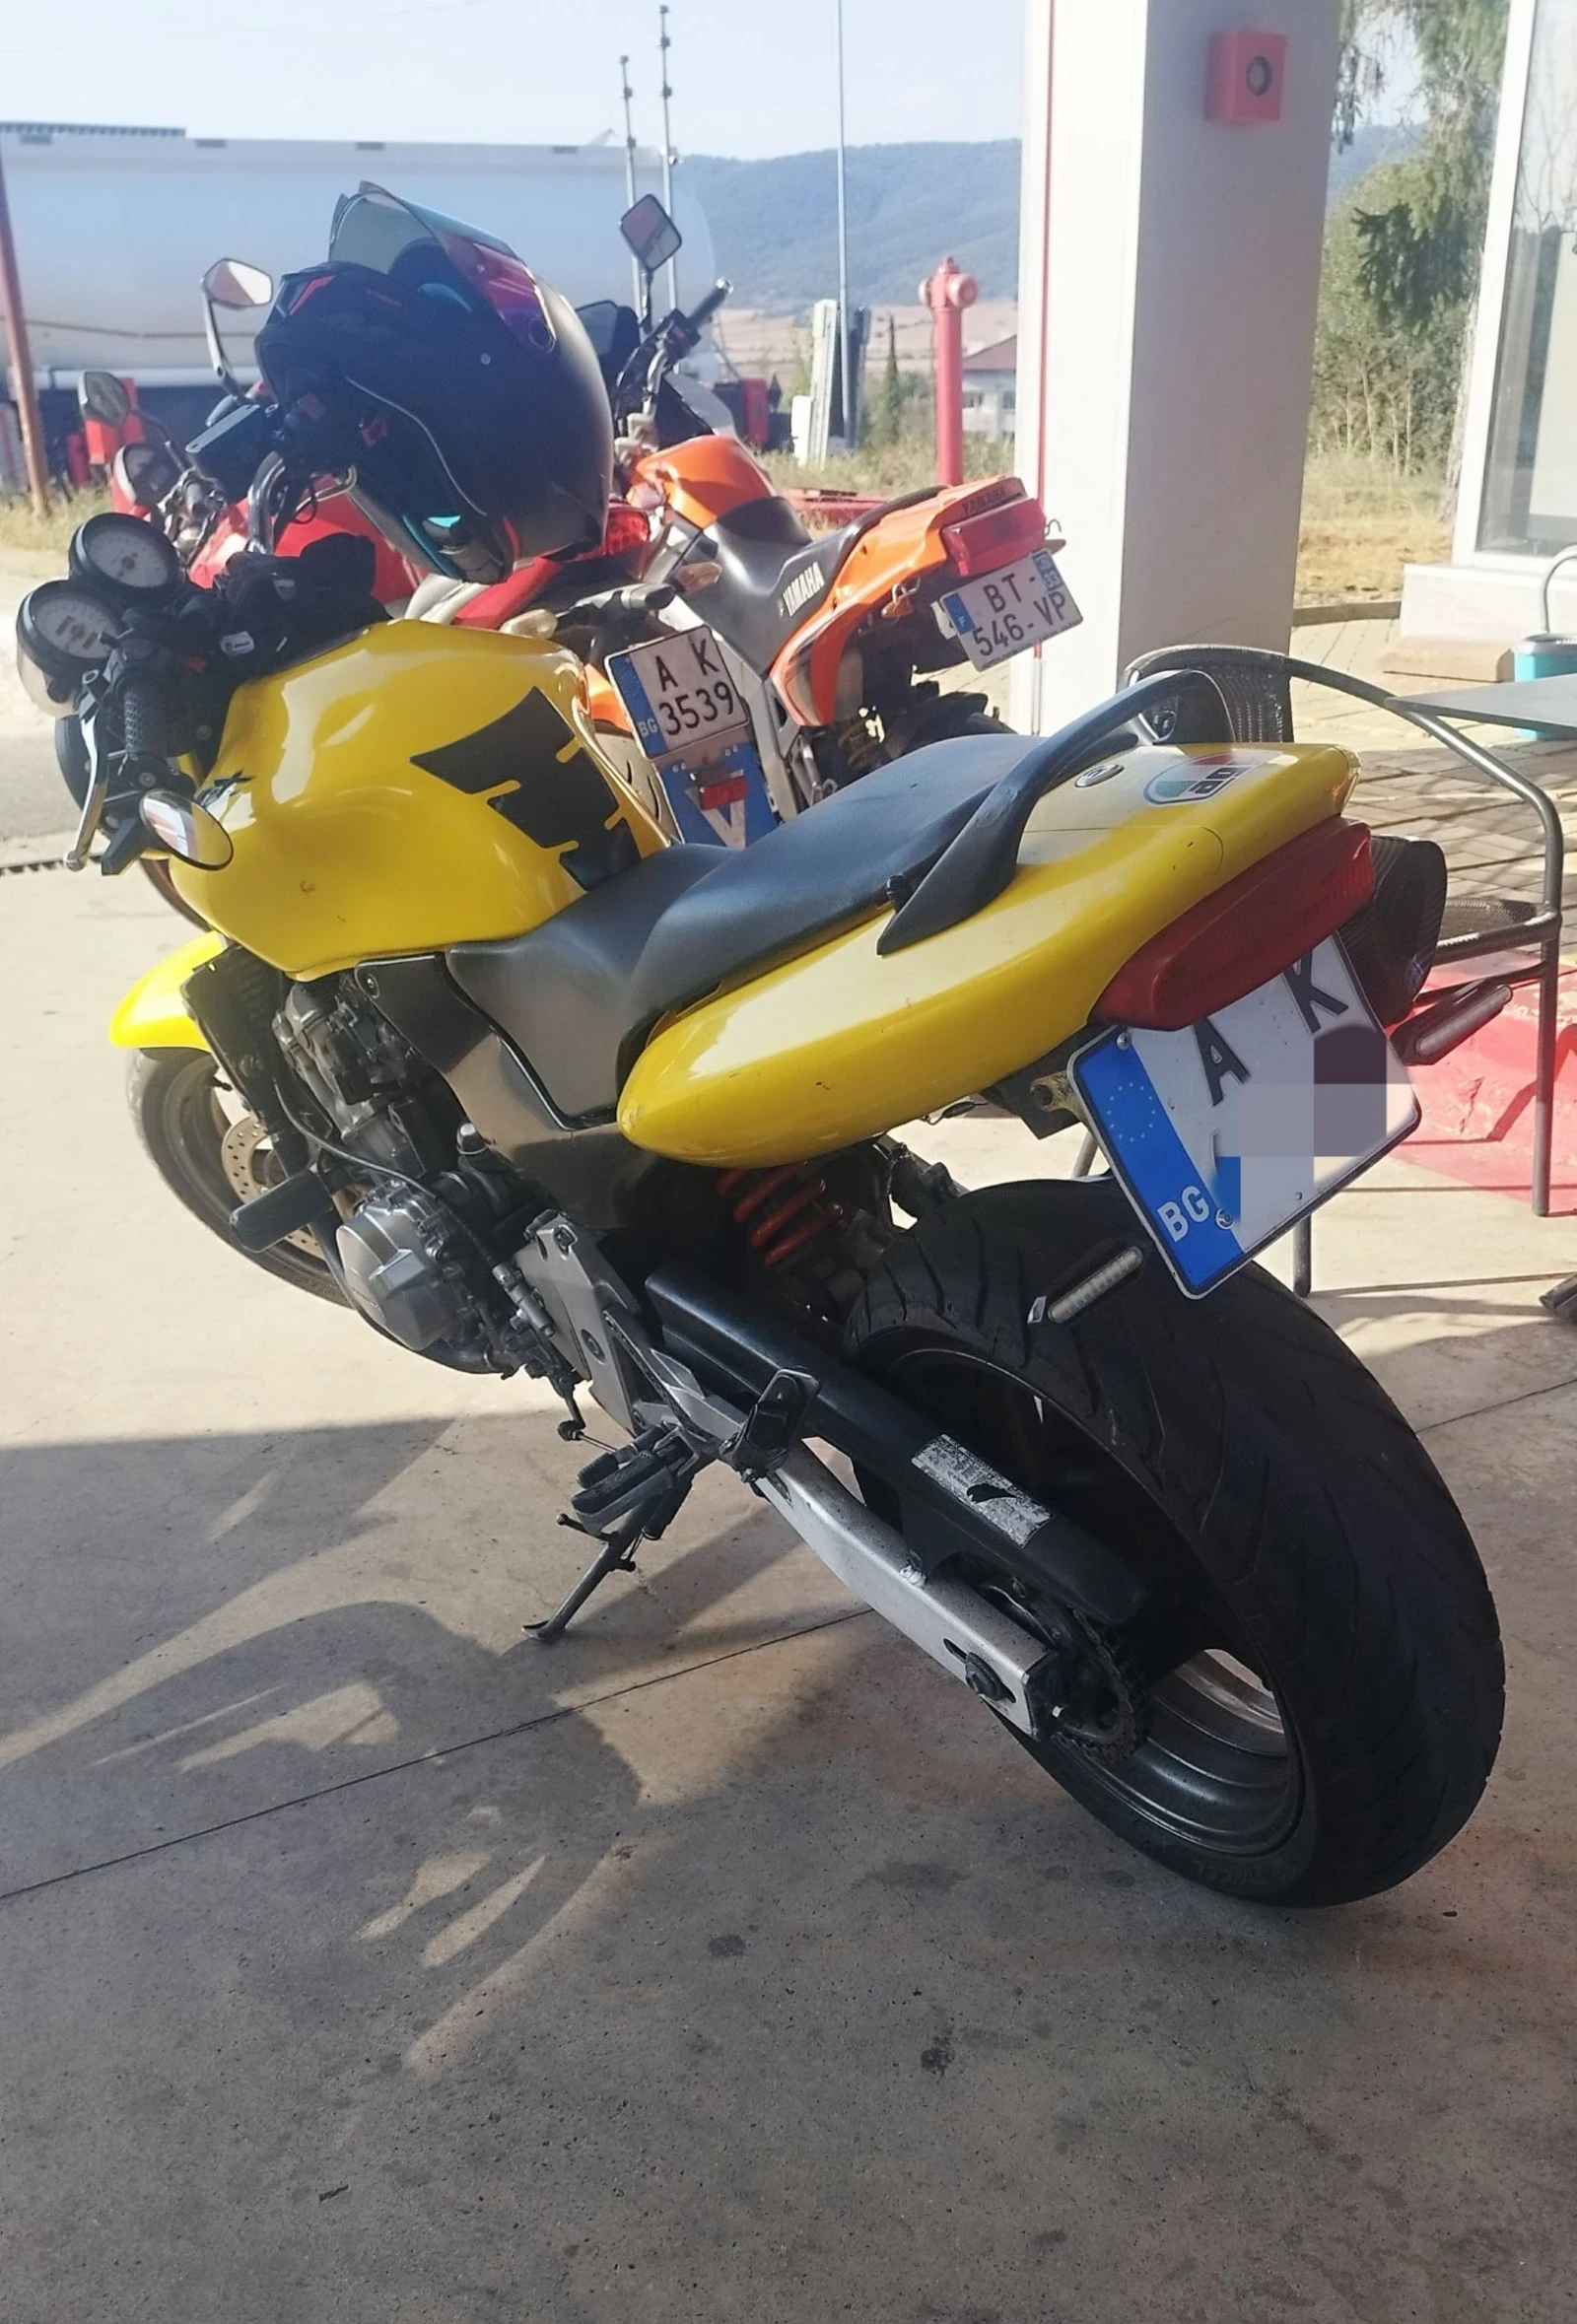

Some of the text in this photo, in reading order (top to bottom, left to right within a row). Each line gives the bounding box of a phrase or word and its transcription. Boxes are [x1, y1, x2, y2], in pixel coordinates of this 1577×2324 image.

[782, 561, 825, 617] YAMAHA
[957, 616, 966, 627] F
[655, 639, 720, 692] A K
[638, 718, 658, 738] BG
[659, 681, 734, 736] 3539
[1192, 950, 1349, 1107] A K
[1157, 1186, 1210, 1243] BG
